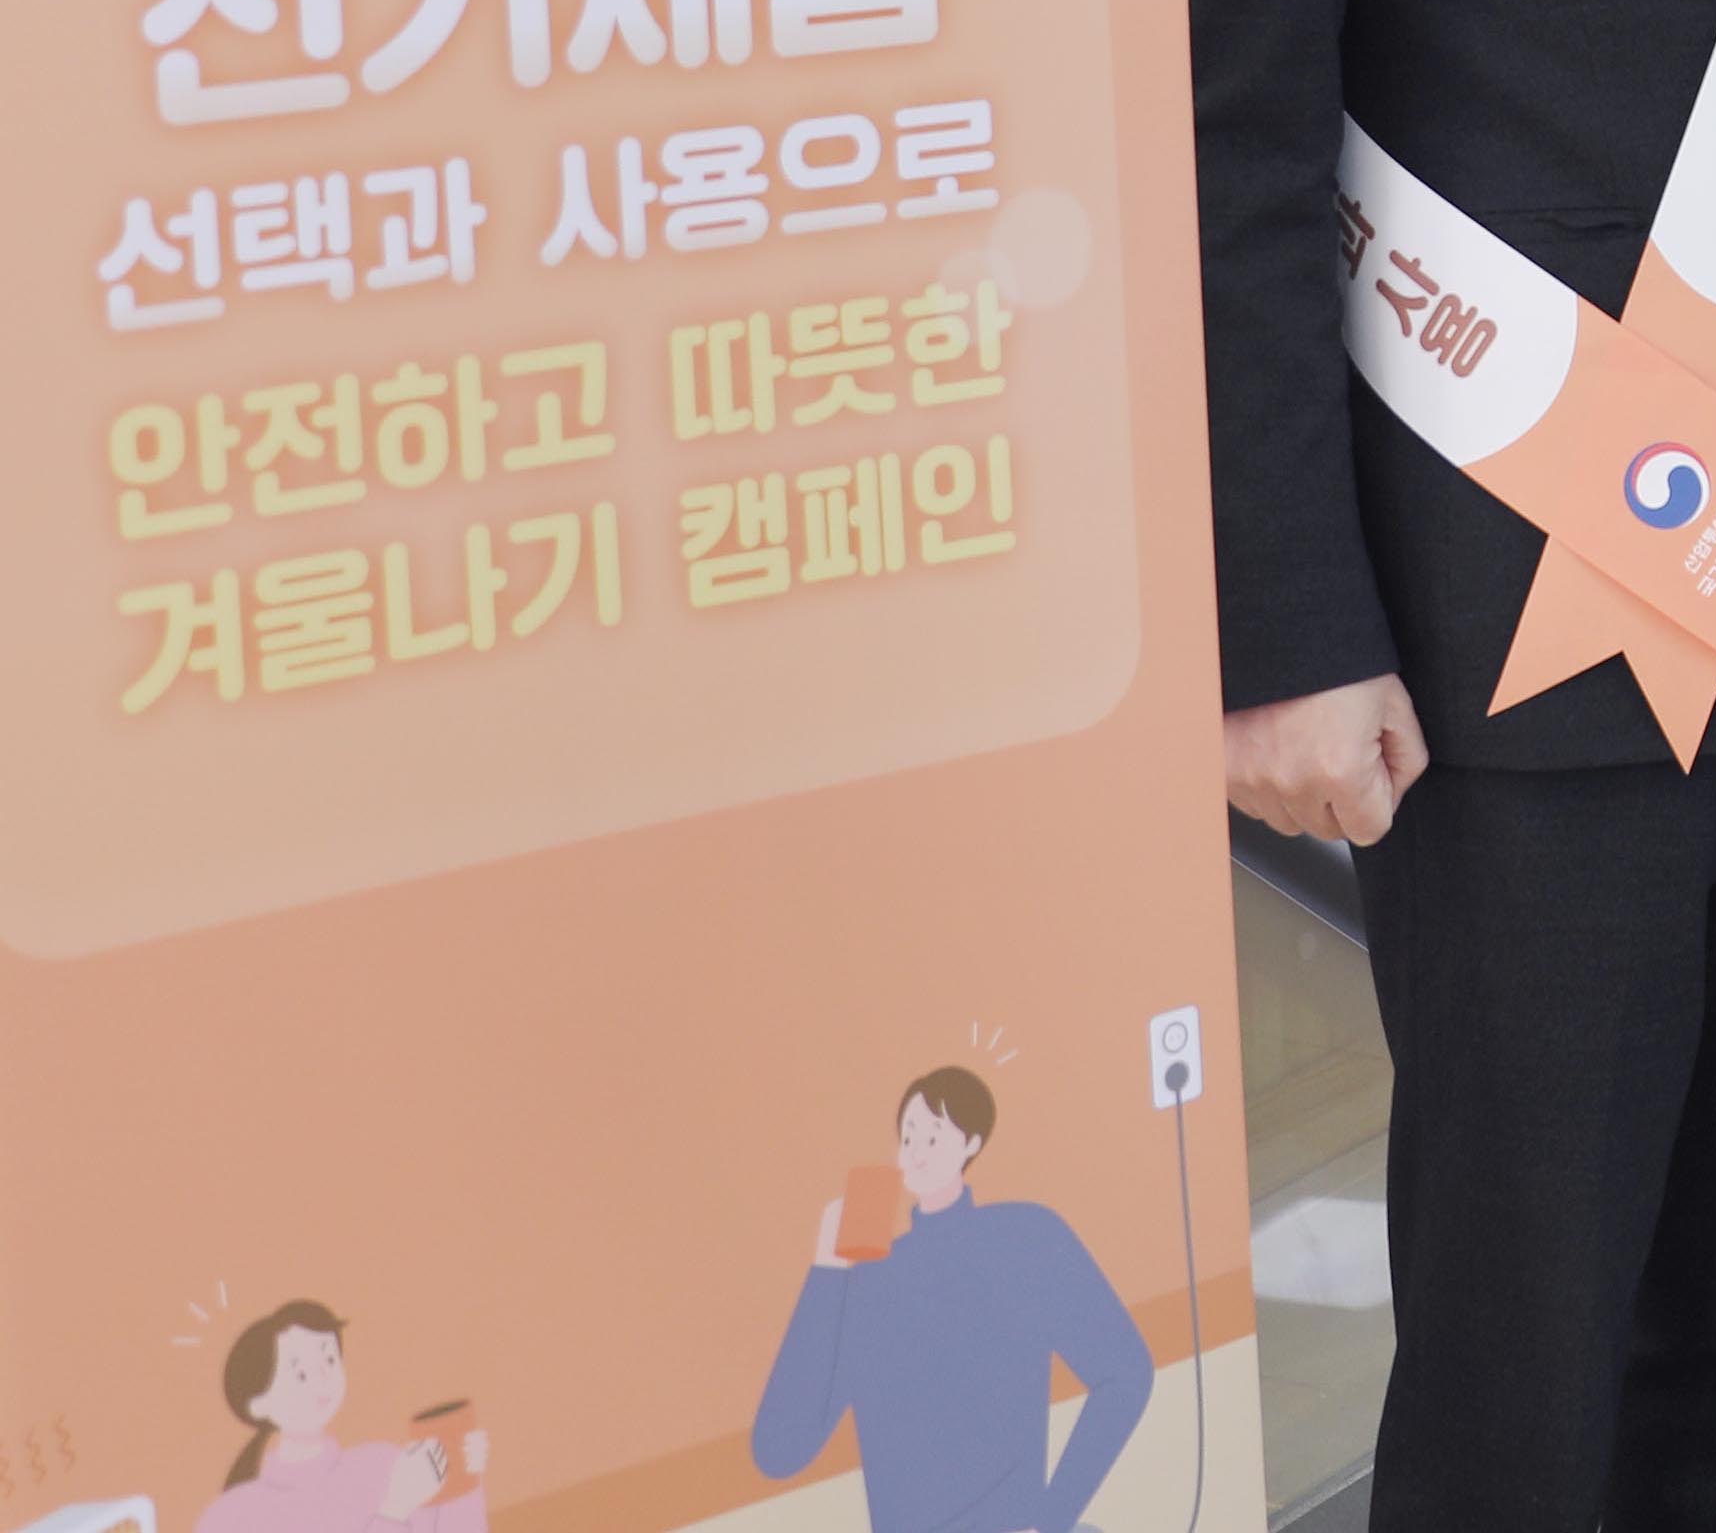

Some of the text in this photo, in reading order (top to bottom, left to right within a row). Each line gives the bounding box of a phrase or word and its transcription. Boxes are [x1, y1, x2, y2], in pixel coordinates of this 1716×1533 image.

[98, 98, 1000, 332] 선택과 사용으로
[1375, 248, 1498, 379] 사용
[108, 279, 1011, 540] 안전하고 따뜻한
[117, 434, 1016, 716] 겨울나기 캠페인
